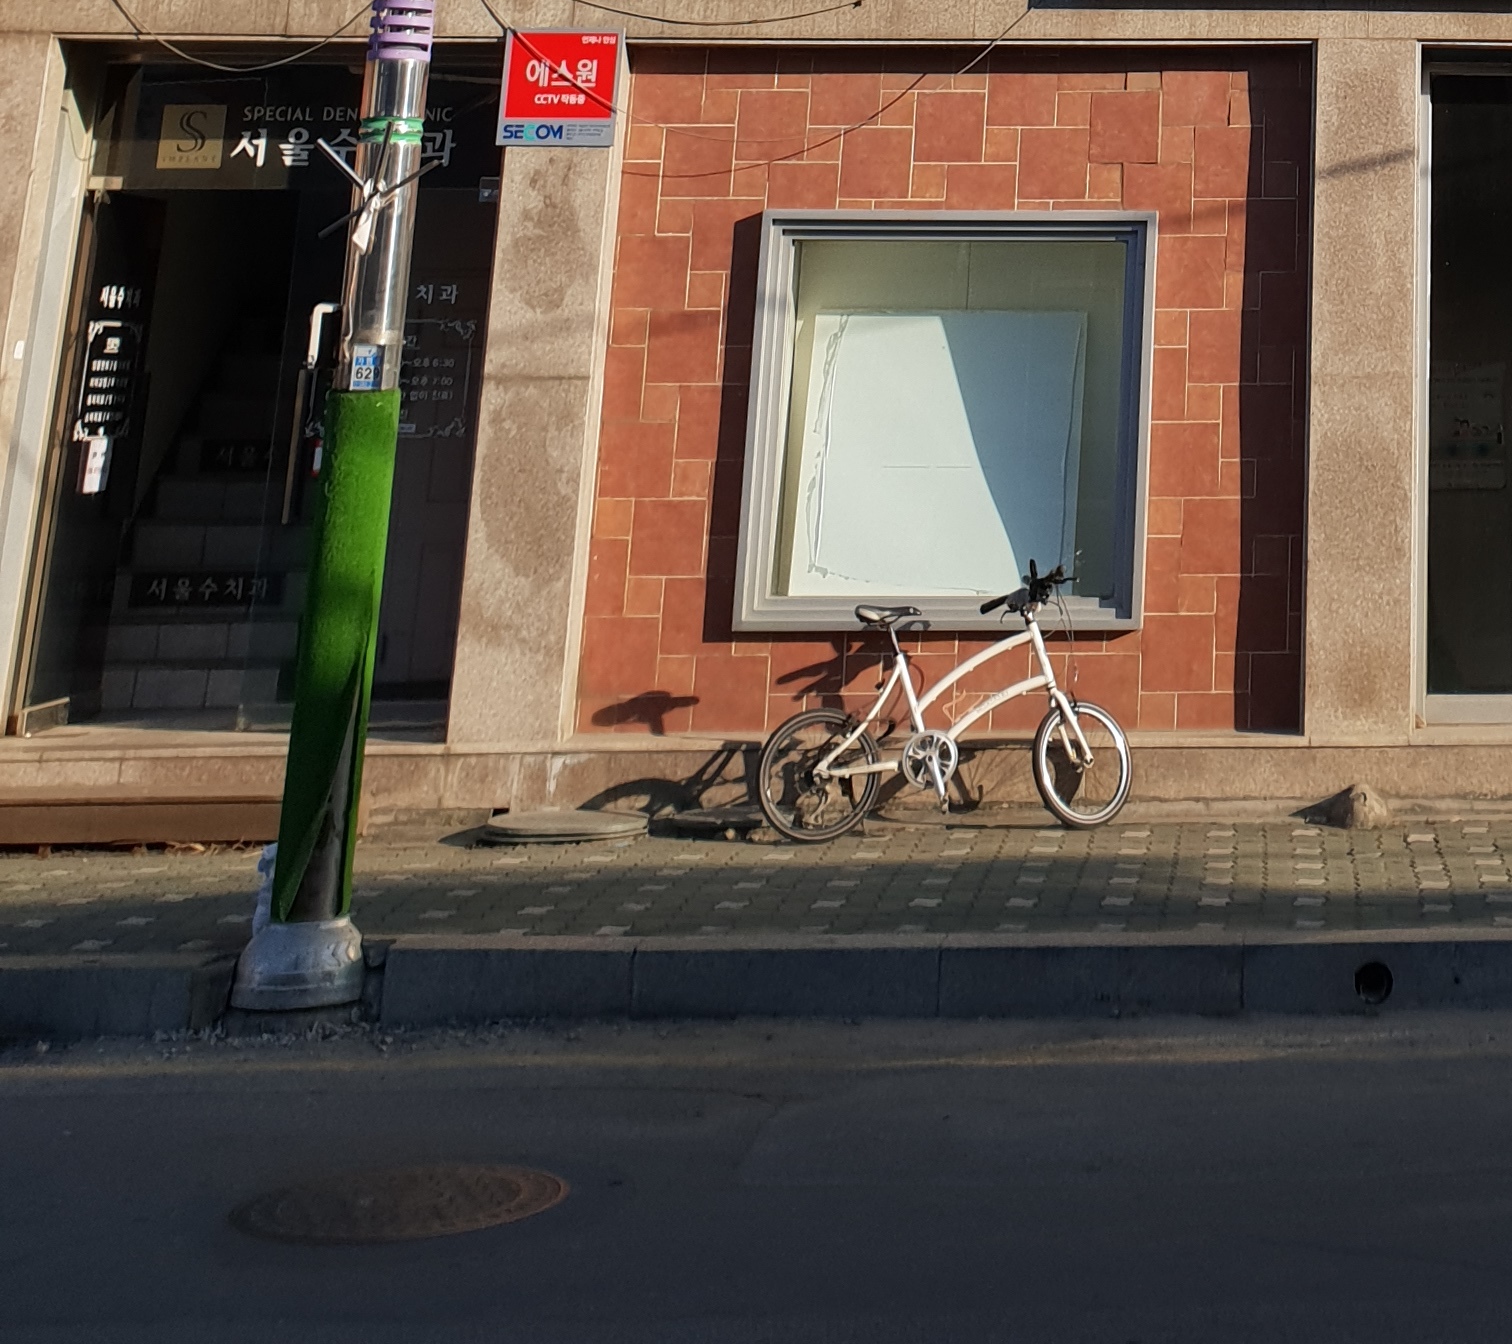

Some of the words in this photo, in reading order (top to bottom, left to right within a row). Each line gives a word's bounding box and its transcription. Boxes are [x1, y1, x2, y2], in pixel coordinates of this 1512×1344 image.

[526, 59, 598, 87] 에스원
[534, 94, 560, 104] CCTV
[242, 106, 314, 122] SPECIAL
[322, 106, 359, 122] DEN
[503, 124, 564, 141] SECOM
[230, 126, 457, 168] 서울수과
